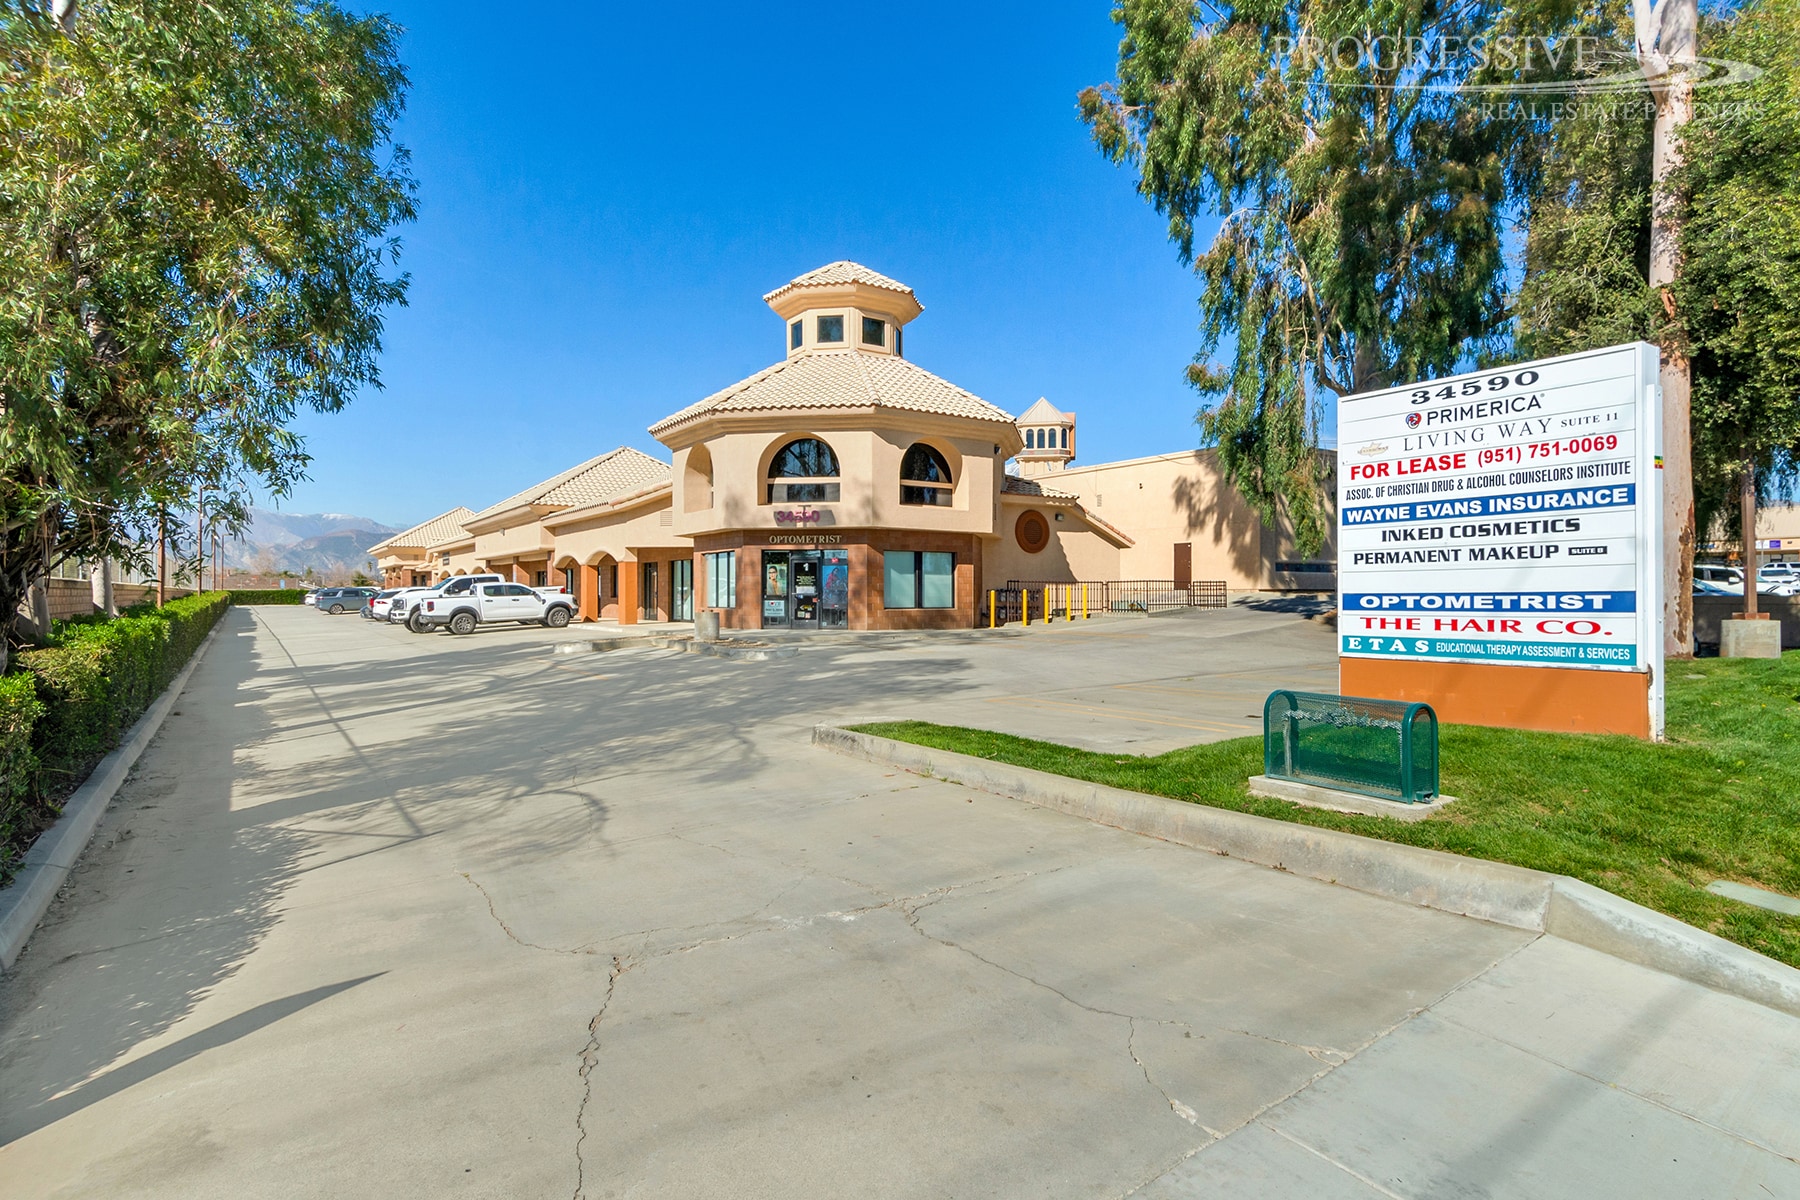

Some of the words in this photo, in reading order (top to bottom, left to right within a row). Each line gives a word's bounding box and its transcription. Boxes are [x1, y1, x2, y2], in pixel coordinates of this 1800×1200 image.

[1410, 370, 1540, 405] 34590
[1427, 394, 1542, 426] PRIMERICA
[1404, 427, 1485, 452] LIVING
[1498, 418, 1552, 438] WAY
[1560, 414, 1601, 428] SUITE
[1606, 412, 1618, 421] 11
[1350, 462, 1390, 480] FOR
[1397, 452, 1466, 475] LEASE
[1477, 446, 1522, 468] (951)
[1528, 434, 1618, 459] 751-0069
[1346, 487, 1374, 501] ASSOC.
[1376, 486, 1385, 498] OF
[1387, 482, 1430, 497] CHRISTIAN
[1432, 479, 1455, 492] DRUG
[1457, 478, 1464, 490] &
[1466, 474, 1507, 489] ALCOHOL
[1509, 466, 1573, 485] COUNSELORS
[1577, 460, 1631, 479] INSTITUTE
[1346, 506, 1410, 523] WAYNE
[1416, 500, 1482, 518] EVANS
[1489, 487, 1628, 513] INSURANCE
[769, 535, 842, 544] OPTOMETRIST
[1382, 527, 1443, 542] INKED
[1450, 518, 1581, 539] COSMETICS
[1354, 549, 1461, 565] PERMANENT
[1468, 544, 1559, 561] MAKEUP
[1570, 547, 1596, 555] SUITE
[1359, 594, 1611, 610] OPTOMETRIST
[1360, 617, 1421, 630] THE
[1434, 618, 1523, 633] HAIR
[1536, 620, 1612, 635] CO.
[1436, 642, 1485, 654] EDUCATIONAL
[1486, 644, 1522, 656] THERAPY
[1522, 645, 1576, 657] ASSESSMENT
[1578, 648, 1584, 658] &
[1586, 648, 1630, 660] SERVICES
